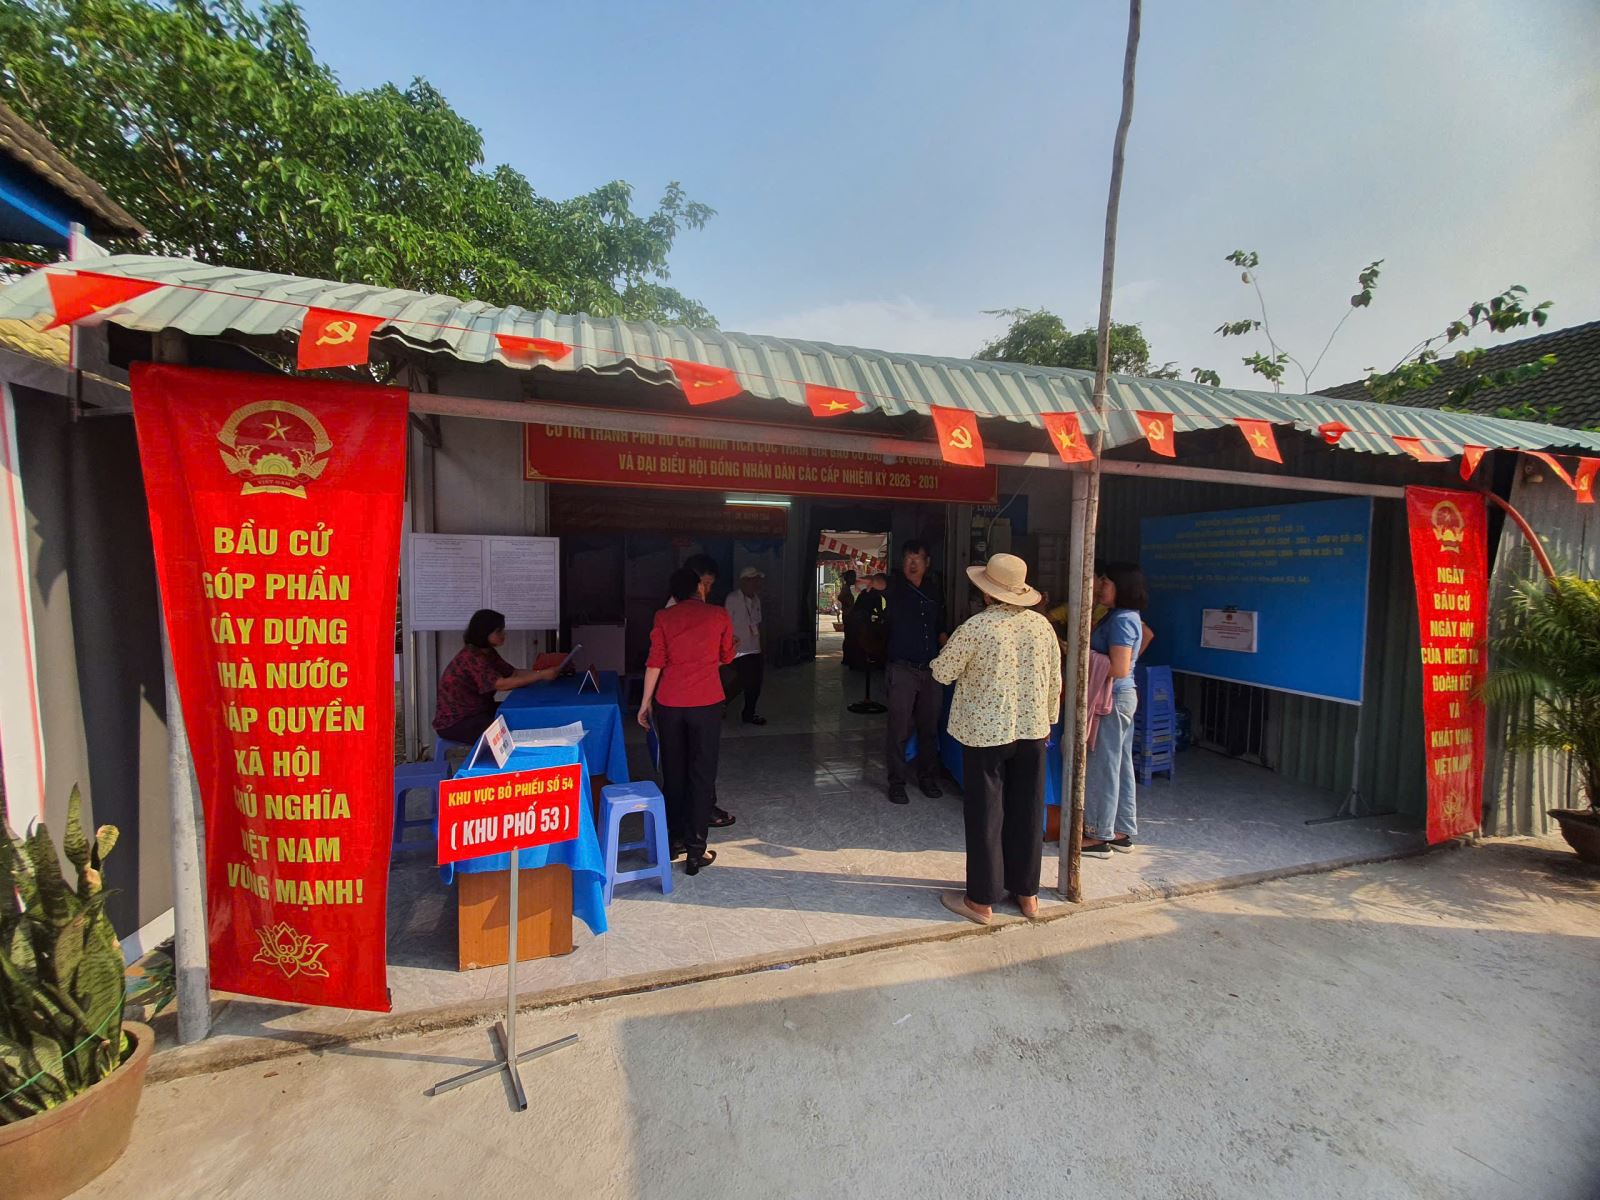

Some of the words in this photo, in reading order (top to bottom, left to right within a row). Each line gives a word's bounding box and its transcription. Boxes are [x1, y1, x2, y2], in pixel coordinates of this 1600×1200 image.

[637, 454, 656, 475] ĐẠI
[660, 451, 685, 474] BIỂU
[689, 456, 707, 479] HỘI
[799, 464, 818, 482] CÁC
[821, 462, 839, 482] CẤP
[843, 468, 872, 489] NHIỆM
[889, 473, 911, 488] 2026
[919, 475, 938, 489] 2031
[214, 518, 278, 555] BẦU
[289, 521, 333, 557] CỬ
[202, 566, 255, 600] GÓP
[265, 565, 350, 600] PHẦN
[1437, 564, 1464, 584] NGÀY
[1433, 588, 1455, 610] BẦU
[1457, 590, 1470, 611] CỬ
[264, 616, 348, 650] DỰNG
[1430, 617, 1457, 637] NGÀY
[1460, 619, 1474, 642] HỘI
[1420, 643, 1441, 664] CỦA
[266, 656, 349, 689] NƯỚC
[267, 698, 365, 737] QUYỀN
[1431, 727, 1454, 748] KHÁT
[234, 746, 265, 776] XÃ
[273, 745, 320, 782] HỘI
[265, 788, 351, 821] NGHĨA
[448, 790, 471, 807] KHU
[474, 787, 495, 805] VỰC
[498, 780, 512, 800] BỎ
[515, 777, 544, 798] PHIẾU
[547, 773, 560, 792] SỐ
[561, 777, 574, 791] 54
[462, 816, 498, 846] KHU
[503, 801, 537, 840] PHỐ
[540, 806, 560, 832] 53
[276, 837, 341, 863] NAM
[275, 878, 364, 912] MẠNH!
